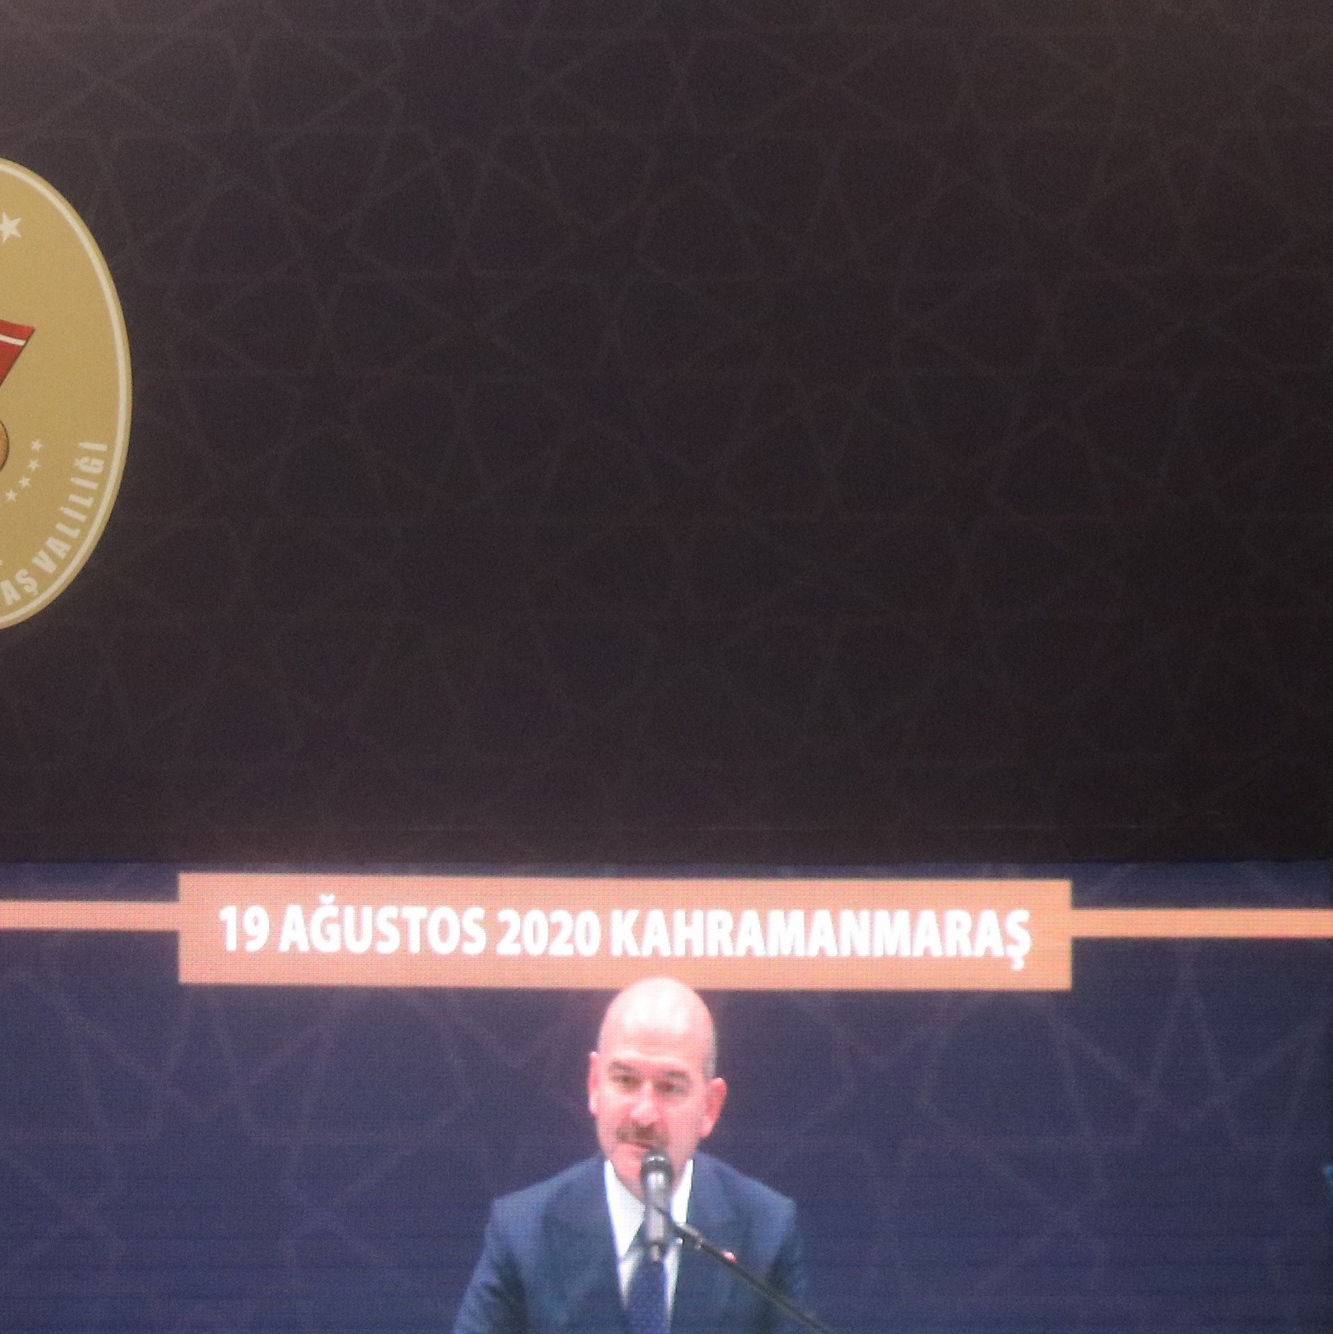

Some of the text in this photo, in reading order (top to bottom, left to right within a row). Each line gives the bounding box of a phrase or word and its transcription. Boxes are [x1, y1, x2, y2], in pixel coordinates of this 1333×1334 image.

[33, 441, 108, 575] VALİLİĞİ
[219, 895, 1031, 972] 19 AĞUSTOS 2020 KAHRAMANMARAŞ
